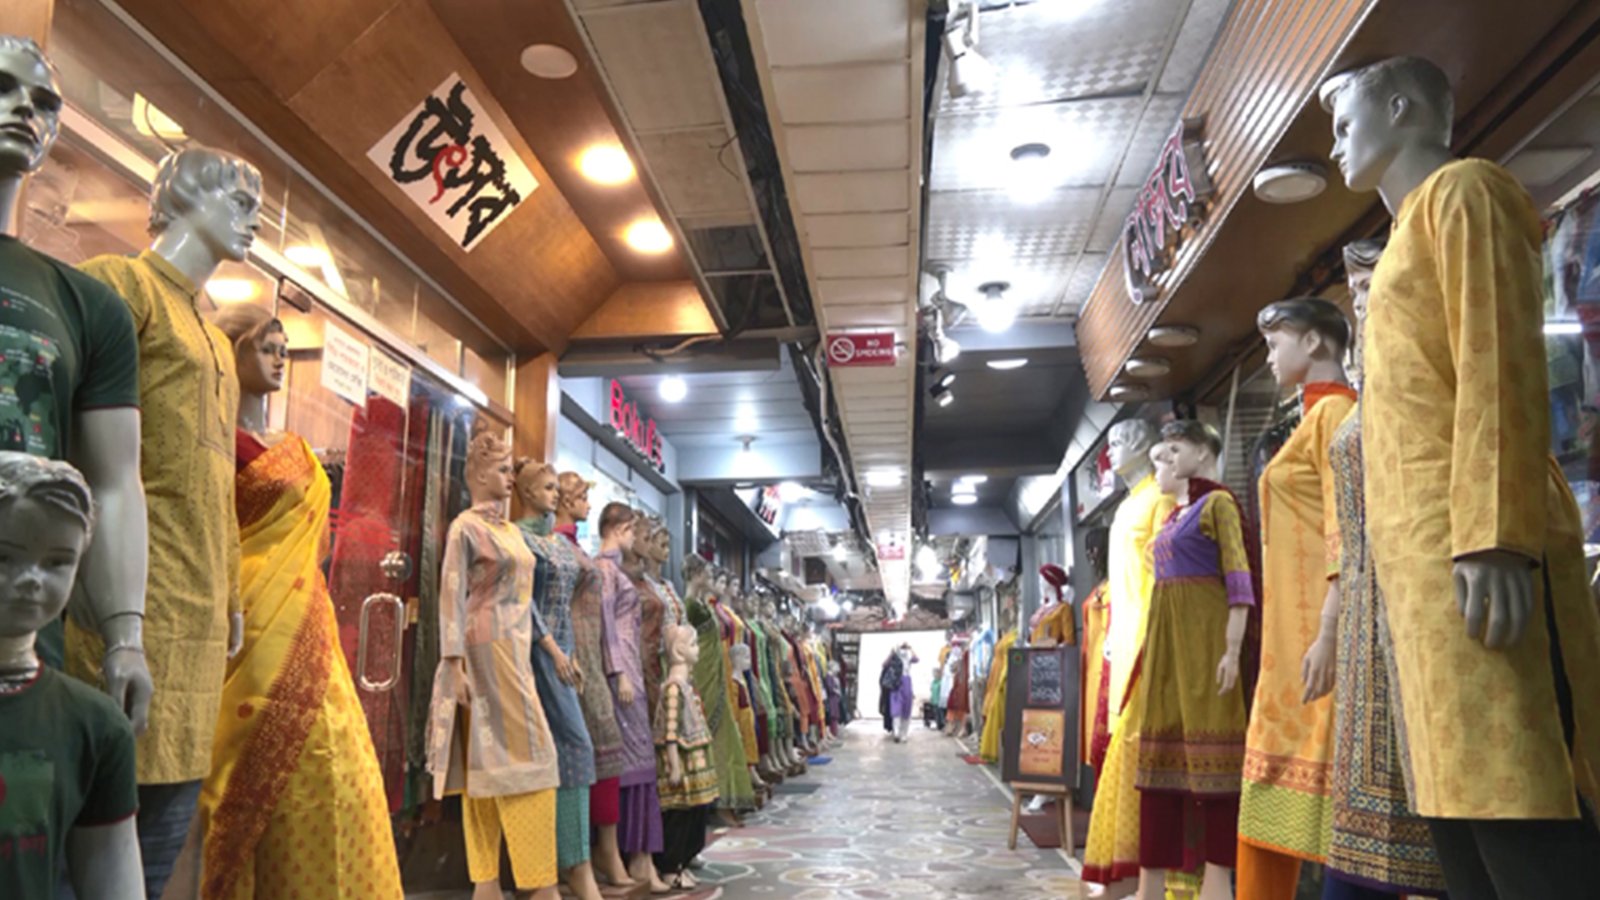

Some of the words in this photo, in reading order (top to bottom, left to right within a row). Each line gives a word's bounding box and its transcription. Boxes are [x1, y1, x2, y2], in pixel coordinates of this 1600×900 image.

[389, 81, 520, 248] উৎসব
[866, 338, 881, 348] NO
[855, 348, 892, 358] SMOKING
